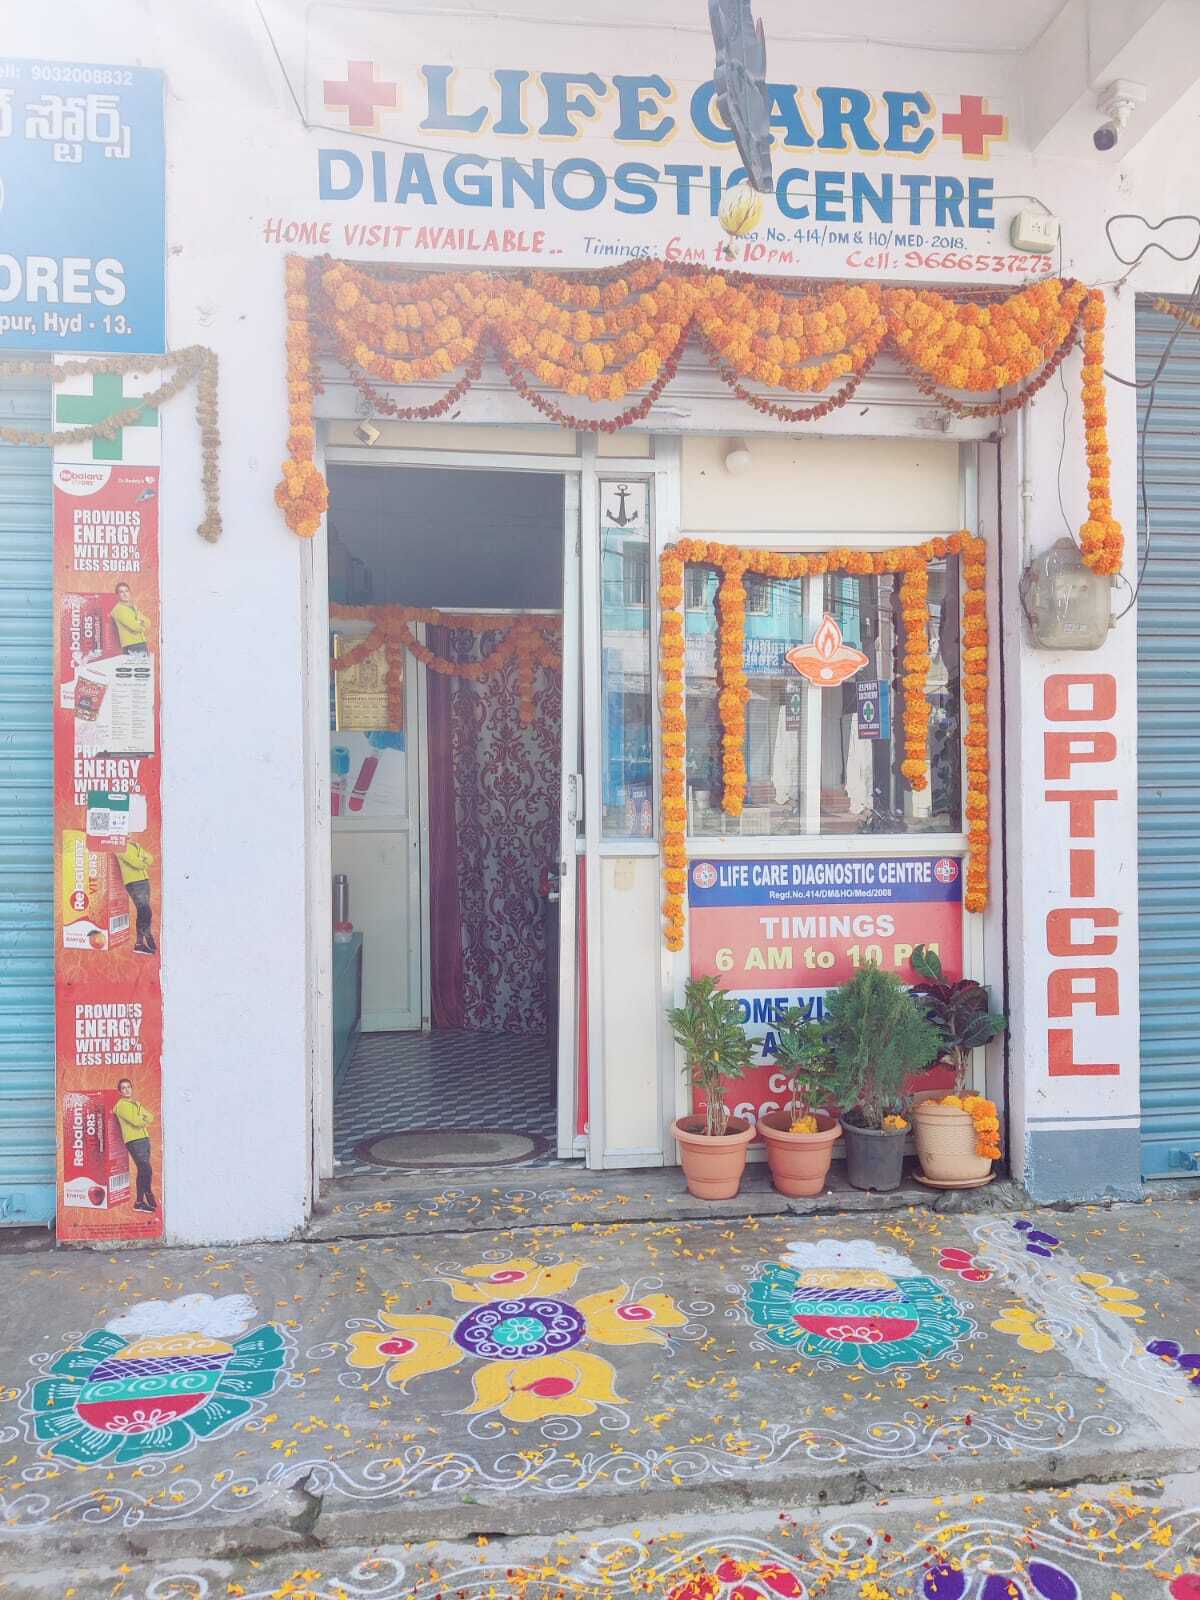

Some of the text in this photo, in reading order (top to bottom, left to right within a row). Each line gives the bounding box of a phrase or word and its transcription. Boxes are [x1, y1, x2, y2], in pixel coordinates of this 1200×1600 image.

[31, 65, 133, 85] 9032008832
[418, 64, 936, 154] LIFE CARE
[317, 148, 995, 230] DIAGNOSTI CENTRE
[263, 217, 332, 244] HOME
[343, 223, 411, 247] VISIT
[846, 250, 1053, 273] Cell: 9666537273
[0, 254, 126, 306] ORES
[44, 312, 82, 336] Hyd
[103, 314, 132, 334] 13.
[73, 509, 141, 525] PROVIDES
[73, 525, 141, 544] ENERGY
[73, 544, 141, 560] WITH 38%
[73, 559, 141, 573] LESS SUGAR
[84, 615, 93, 638] ORS
[74, 759, 141, 778] ENERGY
[74, 778, 141, 793] WITH 38%
[719, 865, 749, 887] LIFE
[752, 864, 788, 886] CARE
[793, 863, 874, 885] DIAGNOSTIC
[879, 861, 932, 883] CENTRE
[1042, 672, 1121, 1076] OPTICAL
[759, 914, 896, 940] TIMINGS
[715, 948, 734, 971] 6
[744, 947, 793, 970] AM
[803, 946, 836, 968] to
[846, 944, 883, 967] 10
[75, 1003, 142, 1019] PROVIDES
[728, 997, 789, 1024] OME
[75, 1019, 142, 1038] ENERGY
[75, 1038, 142, 1053] WITH 38%
[76, 1052, 143, 1066] LESS SUGAR
[87, 1113, 96, 1136] ORS
